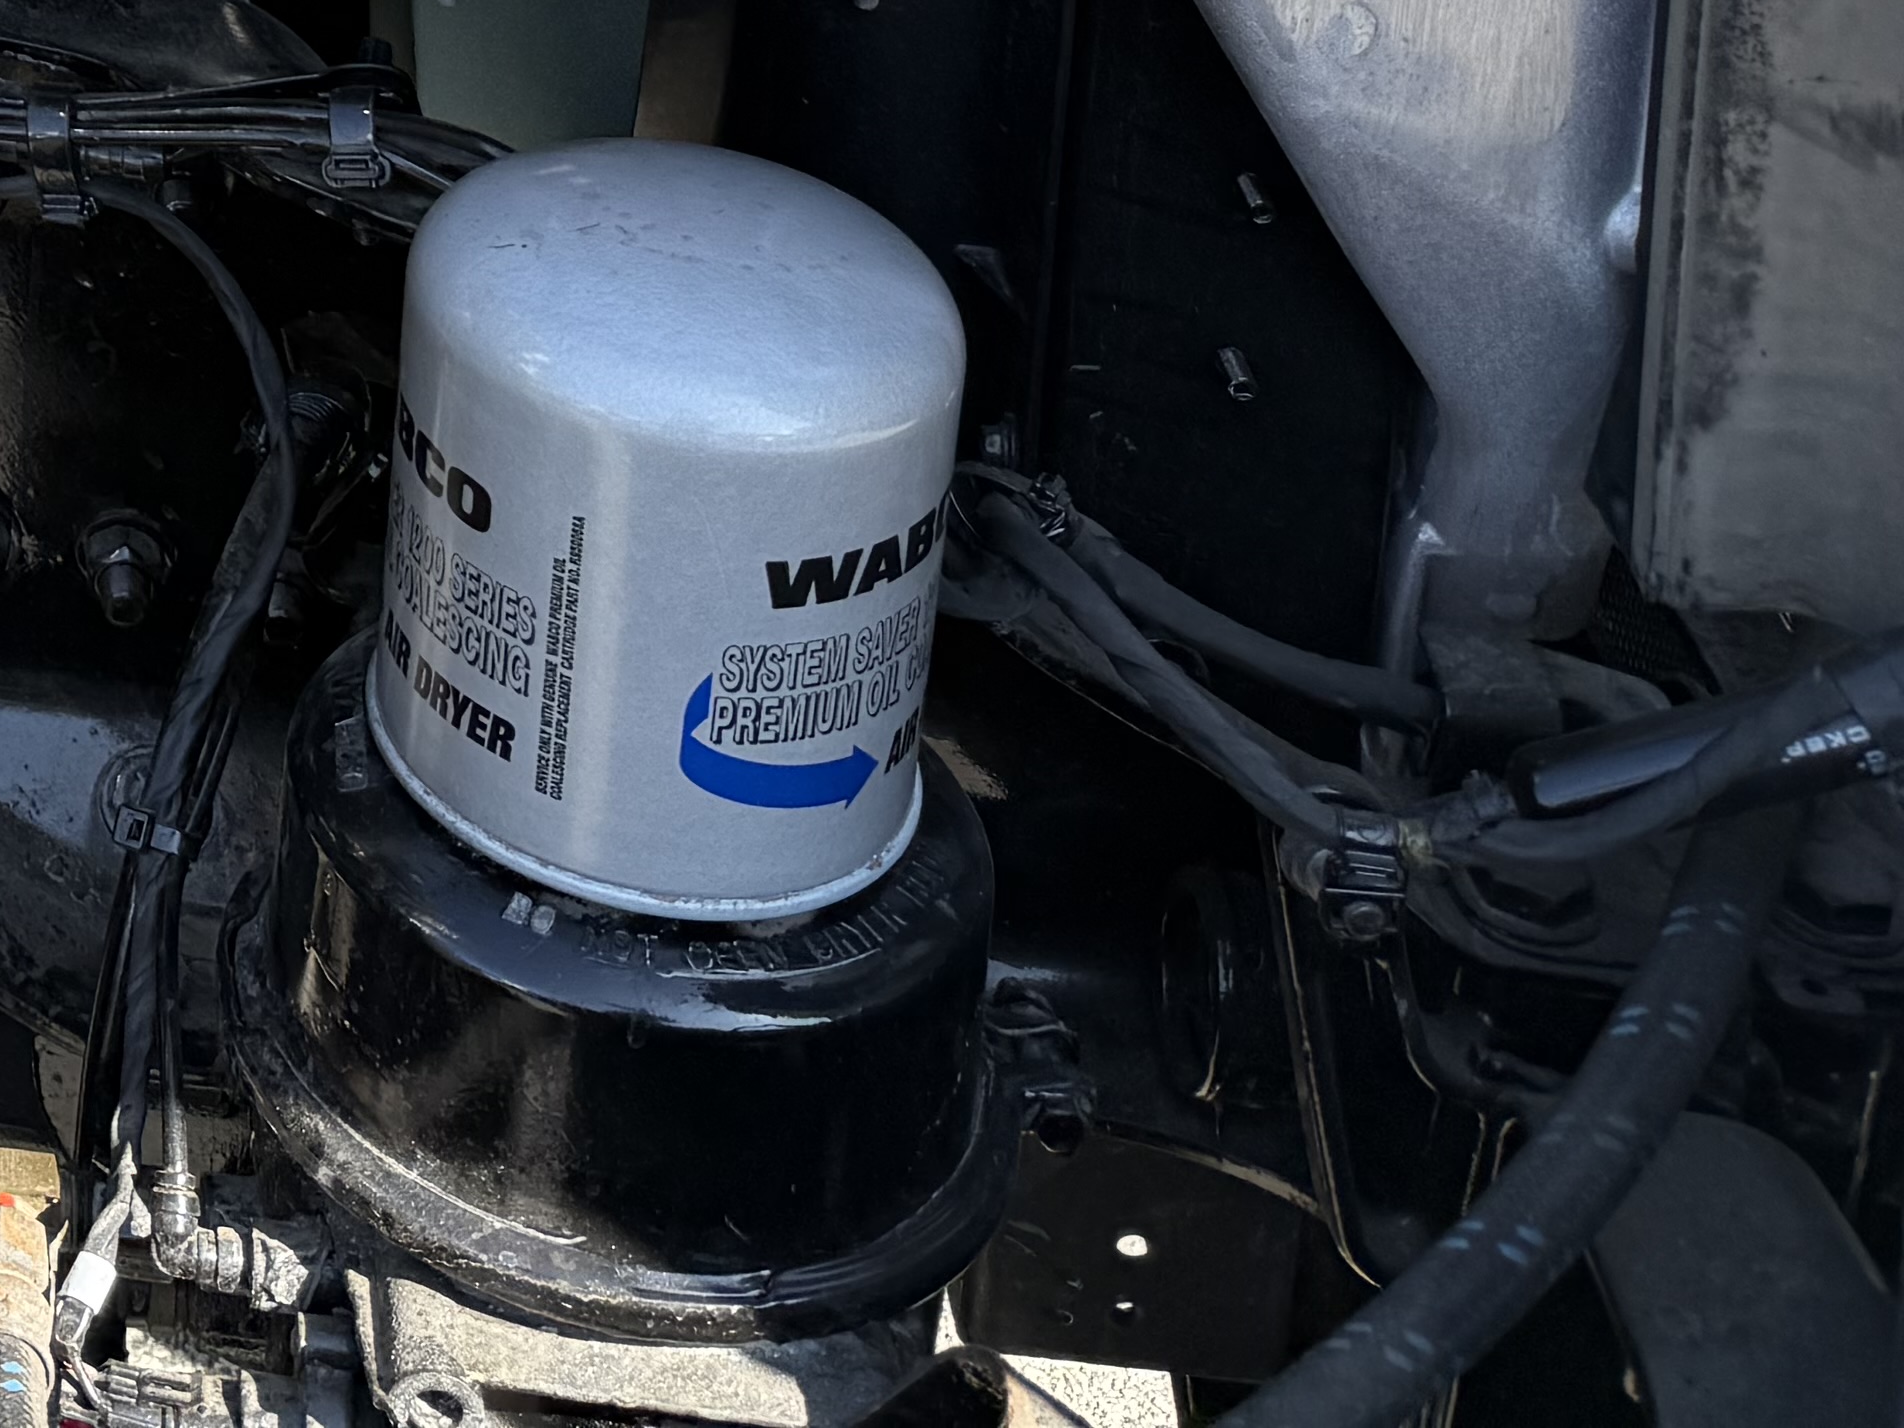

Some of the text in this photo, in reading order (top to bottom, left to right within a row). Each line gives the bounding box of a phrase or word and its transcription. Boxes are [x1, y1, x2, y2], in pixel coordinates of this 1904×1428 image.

[449, 552, 538, 646] SERIES
[563, 587, 579, 612] PART
[535, 557, 566, 794] SERVICE ONLY WITH GENUINE WABCO PREMIUM OIL
[559, 614, 578, 671] CARTRIDGE
[719, 596, 922, 693] SYSTEM SAVER
[413, 654, 517, 764] DRYER
[553, 673, 572, 742] REPLACEMENT
[709, 679, 862, 746] PREMIUM
[865, 661, 900, 718] OIL
[883, 705, 921, 775] AIR
[550, 743, 567, 801] COALESCING
